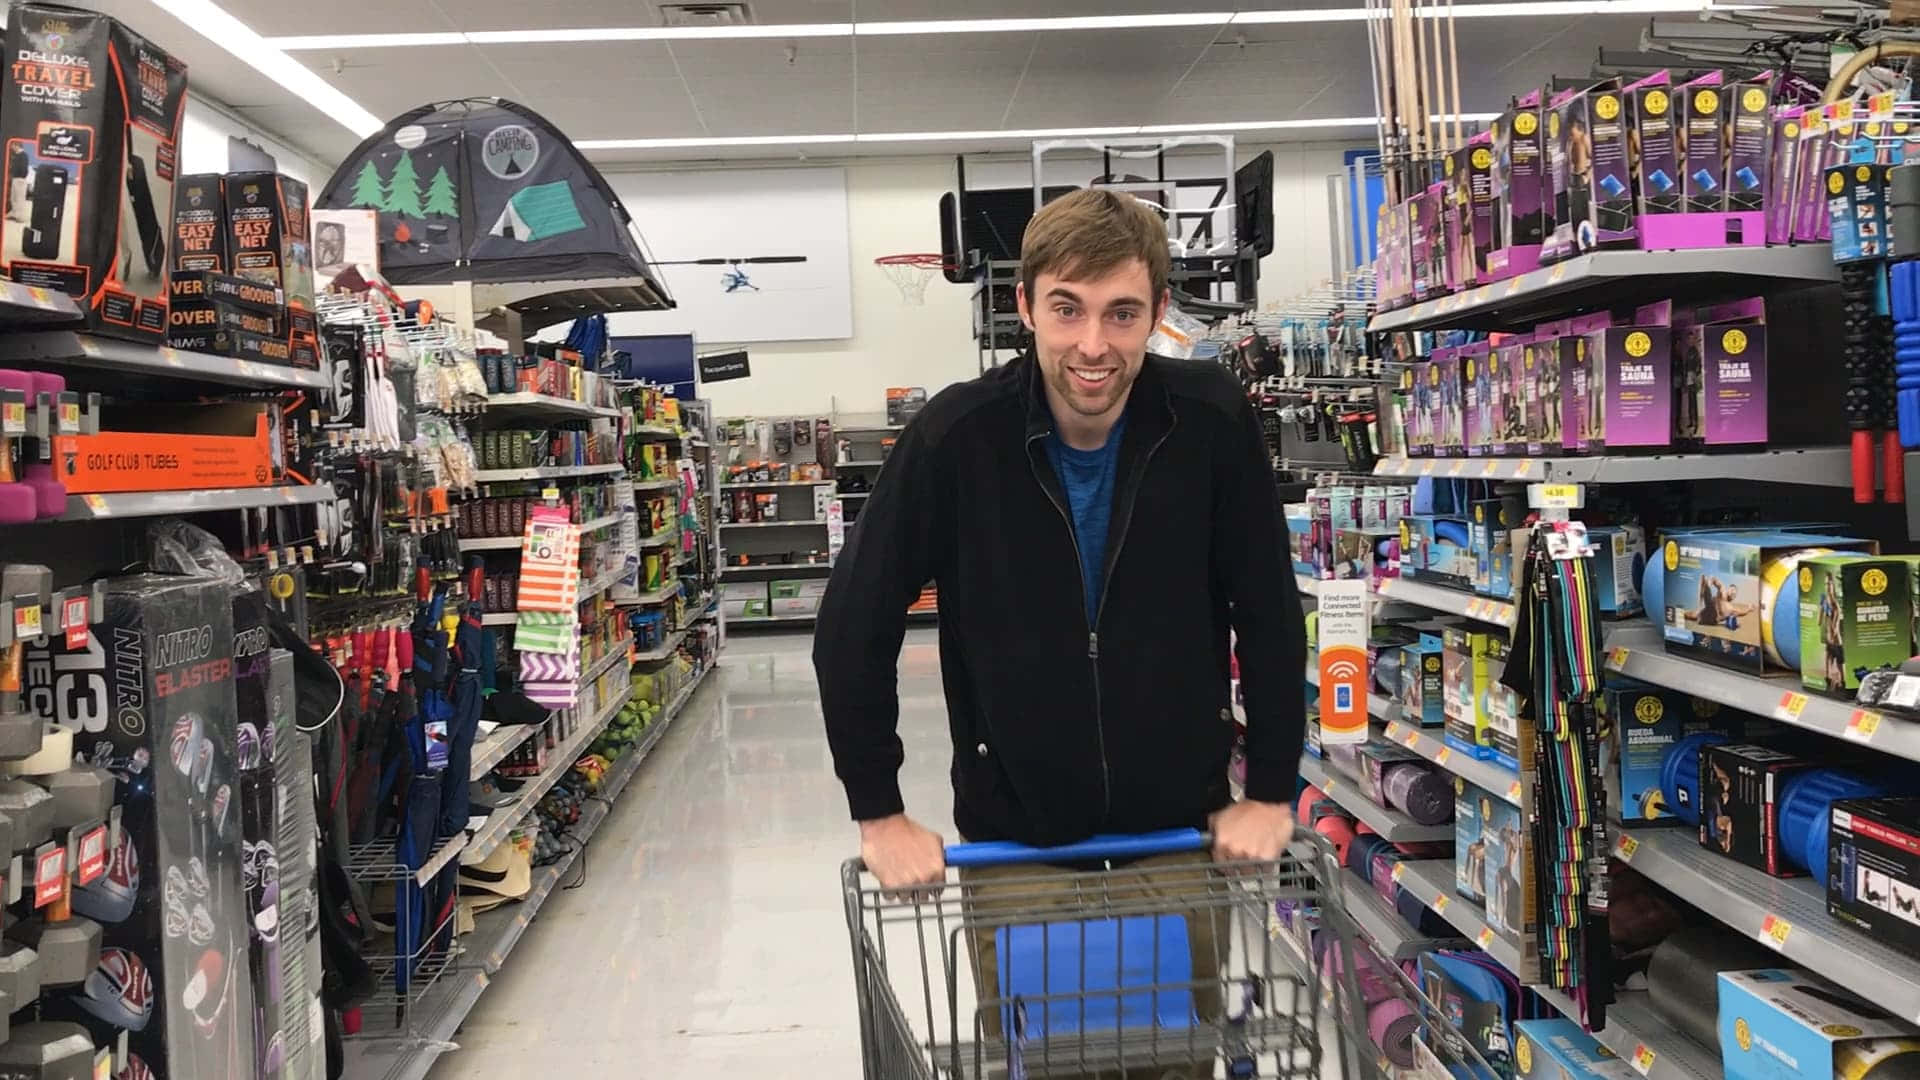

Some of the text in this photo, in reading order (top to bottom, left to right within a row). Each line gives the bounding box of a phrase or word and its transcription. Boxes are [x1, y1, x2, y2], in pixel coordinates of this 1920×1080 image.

[18, 50, 89, 67] DELUXE
[12, 63, 95, 88] TRAVEL
[21, 84, 81, 99] COVER
[21, 95, 43, 103] WITH
[488, 136, 532, 156] CAMPING
[177, 223, 216, 239] EASY
[233, 221, 272, 236] EASY
[183, 238, 212, 251] NET
[239, 235, 268, 248] NET
[171, 279, 203, 296] VER
[170, 310, 216, 326] OVER
[1620, 371, 1655, 382] SAUNA
[1718, 368, 1752, 379] SAUNA
[87, 454, 113, 471] GOLF
[115, 454, 140, 470] CLUB
[144, 454, 179, 470] TUBES
[154, 624, 213, 669] NITRO
[27, 631, 53, 725] PIEC
[55, 629, 109, 734] 13
[113, 627, 146, 737] NITRO
[155, 657, 232, 698] BLASTER
[1628, 735, 1676, 745] ABDOMINAL
